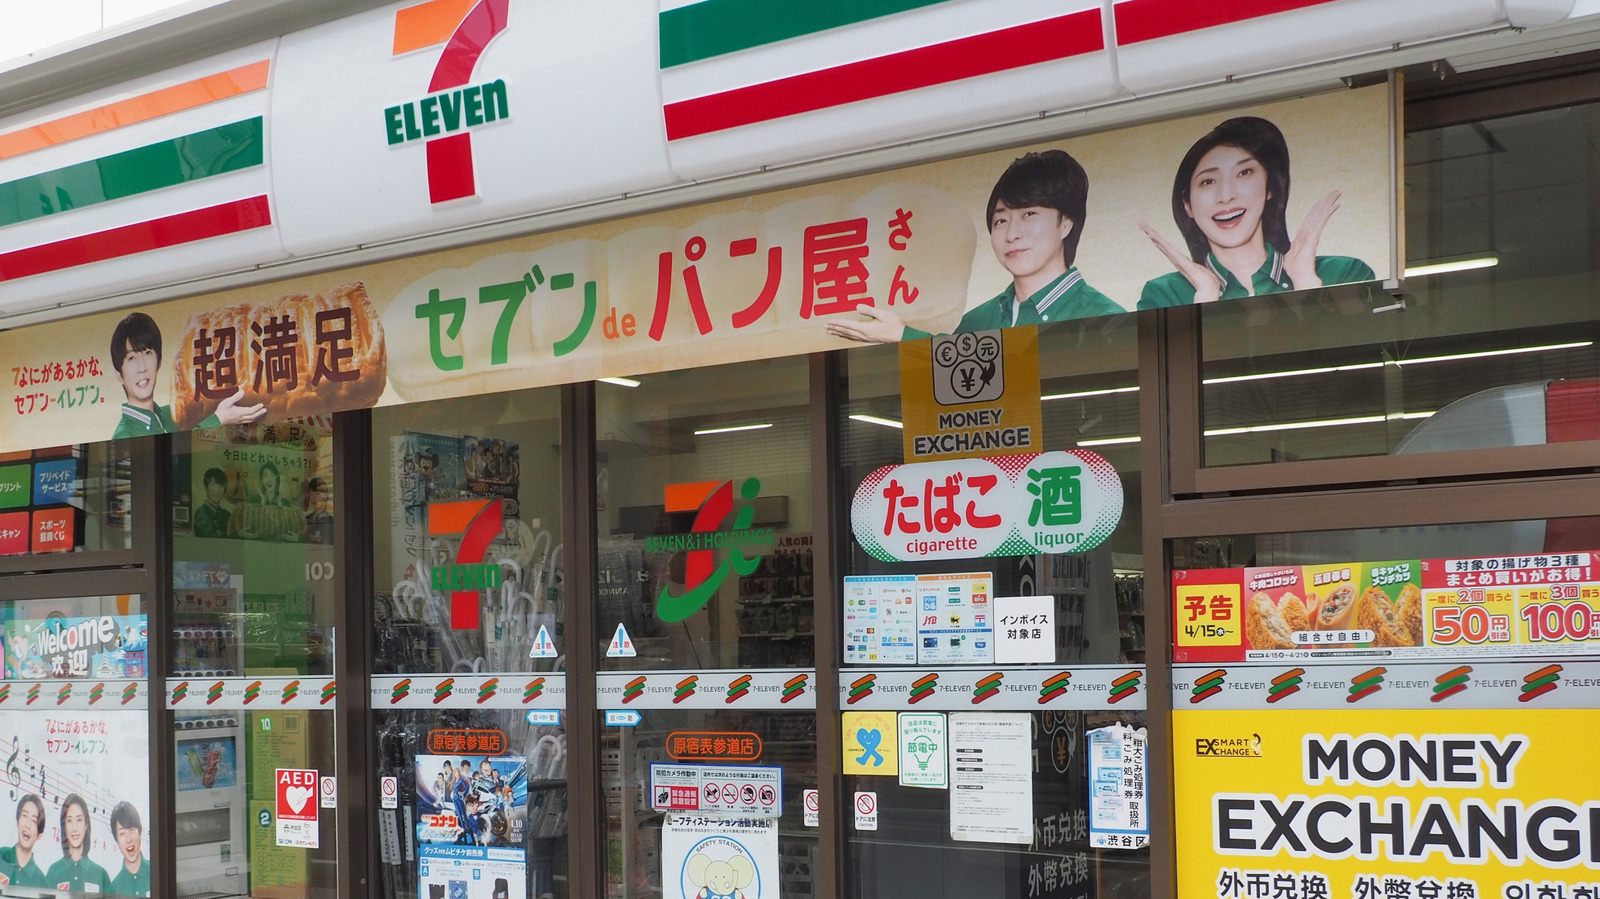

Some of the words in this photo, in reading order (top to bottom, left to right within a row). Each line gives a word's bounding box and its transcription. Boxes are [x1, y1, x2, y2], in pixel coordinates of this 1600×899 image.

[393, 0, 509, 204] 7
[415, 264, 597, 371] セブン
[603, 309, 636, 340] de
[648, 216, 875, 342] パン屋
[193, 306, 360, 402] 超満足
[939, 409, 1003, 429] MONEY
[914, 427, 1031, 455] EXCHANGE
[883, 471, 1002, 536] たばこ
[1027, 465, 1082, 527] 酒
[704, 529, 774, 549] HOLDINGS
[906, 536, 978, 556] cigarette
[1034, 531, 1084, 548] liquor
[1456, 555, 1579, 571] 対象の揚げ物3種
[1249, 576, 1298, 591] 牛肉コロッケ
[1372, 572, 1411, 587] メンチカツ
[1429, 595, 1455, 604] 一度に
[1487, 593, 1512, 602] 買うと
[1520, 591, 1547, 600] 一度に
[1184, 595, 1233, 621] 予告
[1000, 614, 1048, 626] インボイス
[38, 615, 115, 656] Welcome
[1007, 628, 1041, 640] 対象店
[52, 649, 88, 676] 欢迎
[433, 735, 500, 751] 原宿表参道店
[673, 737, 754, 755] 原宿表参道店
[908, 742, 938, 753] 節電中
[1308, 740, 1522, 782] MONEY
[279, 771, 315, 786] AED
[260, 814, 270, 826] 2
[430, 815, 457, 828] コナン
[1129, 801, 1140, 828] 取扱所
[695, 840, 717, 853] SAFETY
[718, 839, 743, 854] STATION
[1107, 834, 1145, 847] 渋谷区
[1219, 871, 1327, 899] 外币兑换
